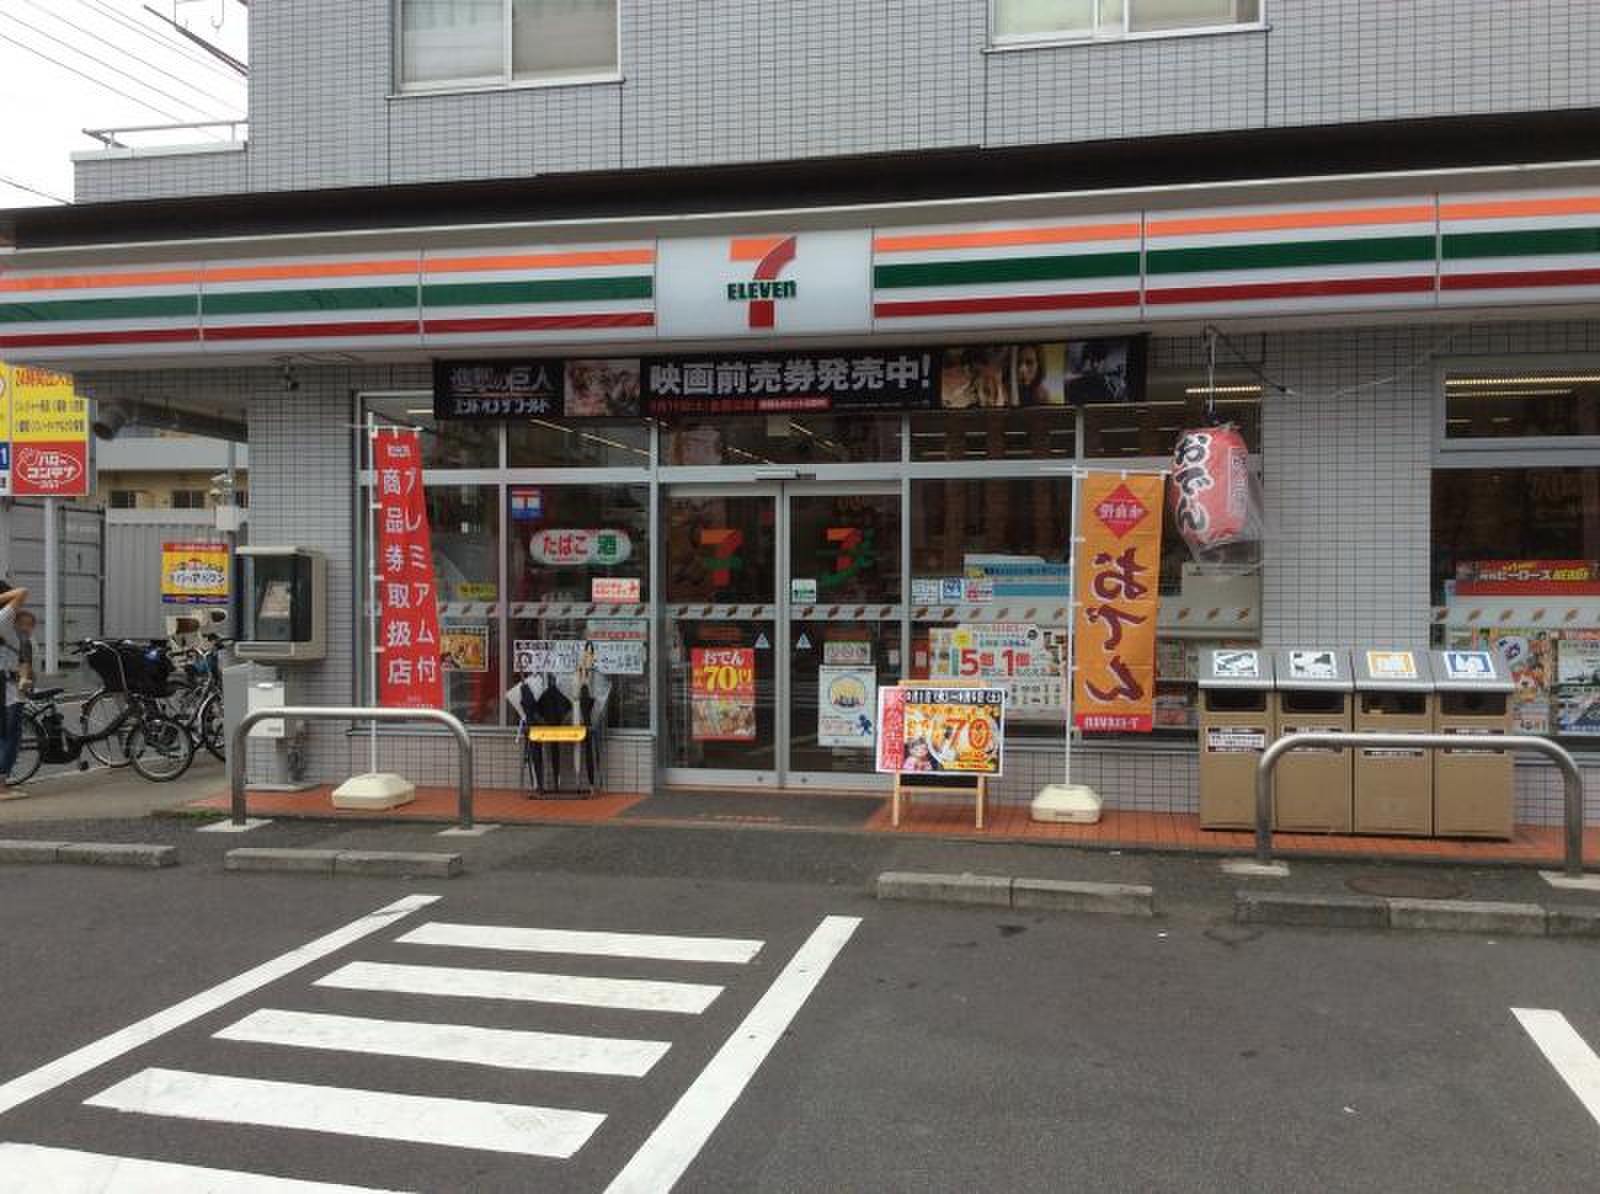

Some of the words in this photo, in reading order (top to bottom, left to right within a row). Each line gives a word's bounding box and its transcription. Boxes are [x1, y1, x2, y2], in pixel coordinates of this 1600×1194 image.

[729, 236, 797, 327] 7
[383, 468, 412, 686] 商品券取扱店
[543, 535, 588, 556] たばこ
